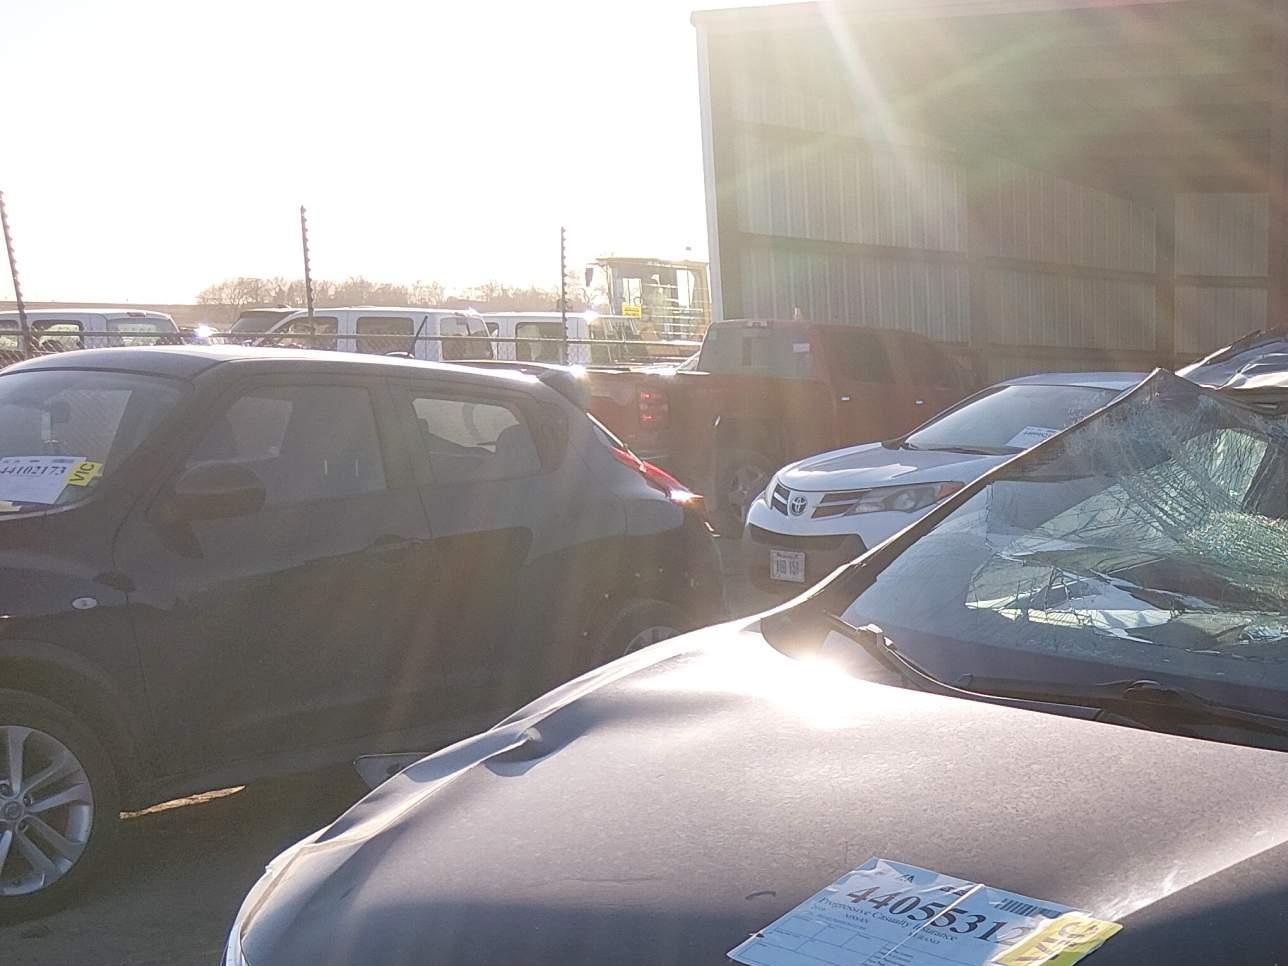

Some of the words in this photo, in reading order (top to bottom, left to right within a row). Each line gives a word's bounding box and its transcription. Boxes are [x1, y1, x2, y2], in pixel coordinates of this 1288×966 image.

[69, 463, 95, 482] VIC
[847, 886, 1034, 946] 44055312
[871, 908, 909, 928] Casualty
